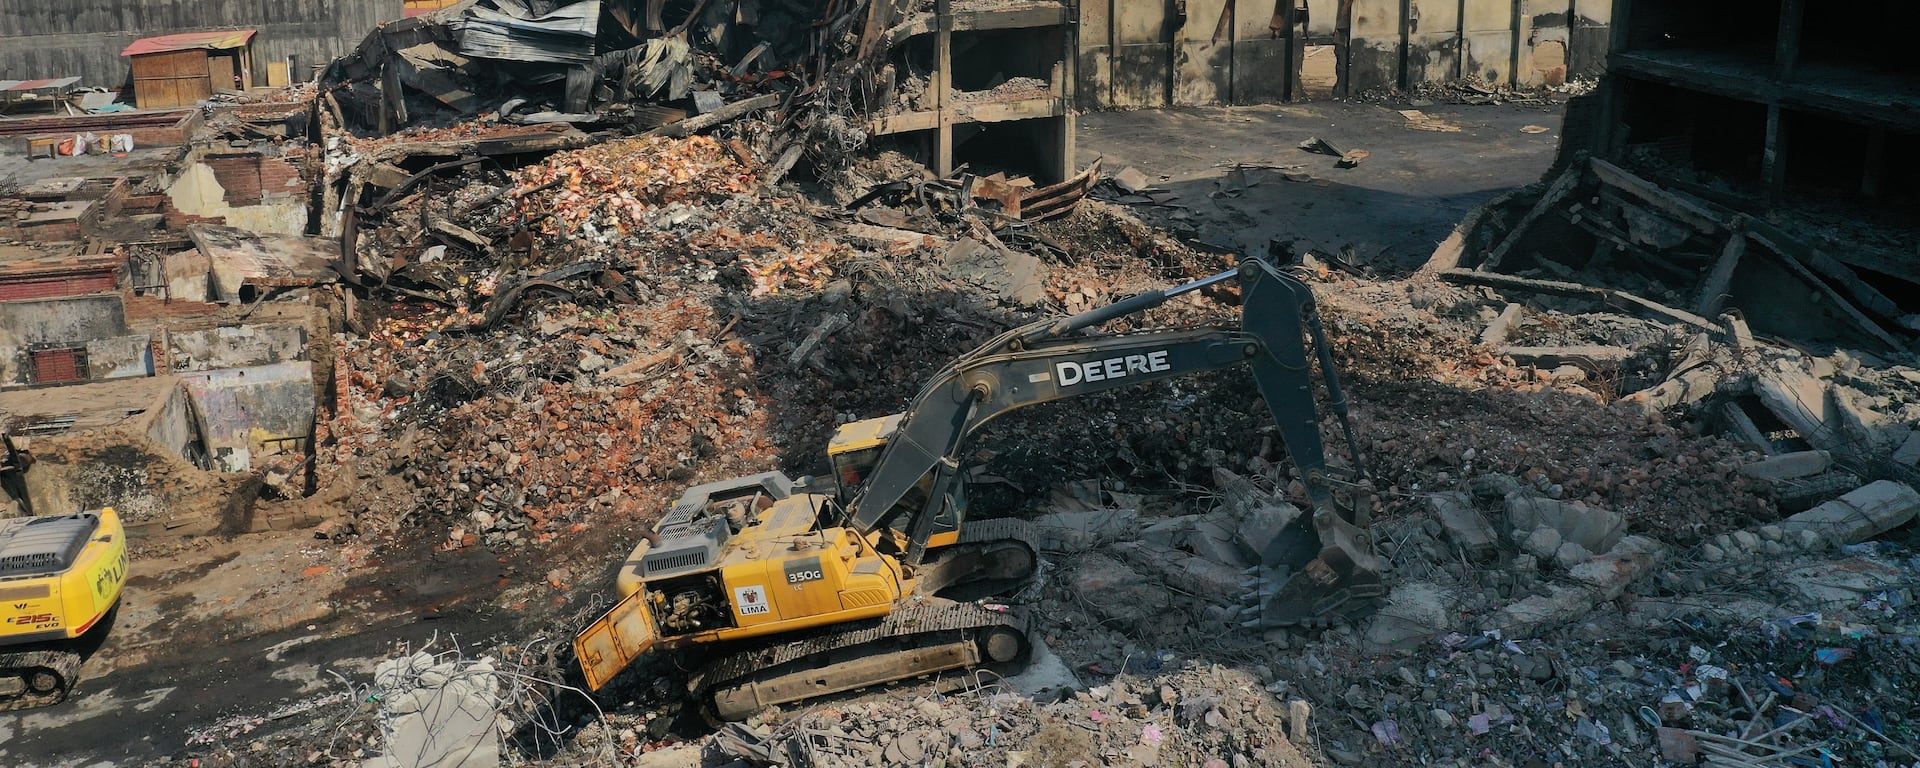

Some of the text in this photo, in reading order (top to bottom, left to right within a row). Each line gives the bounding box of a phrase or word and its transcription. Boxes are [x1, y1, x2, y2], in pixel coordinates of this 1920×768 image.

[1056, 350, 1170, 386] DEERE
[788, 570, 821, 583] 350G
[740, 605, 767, 615] LIMA
